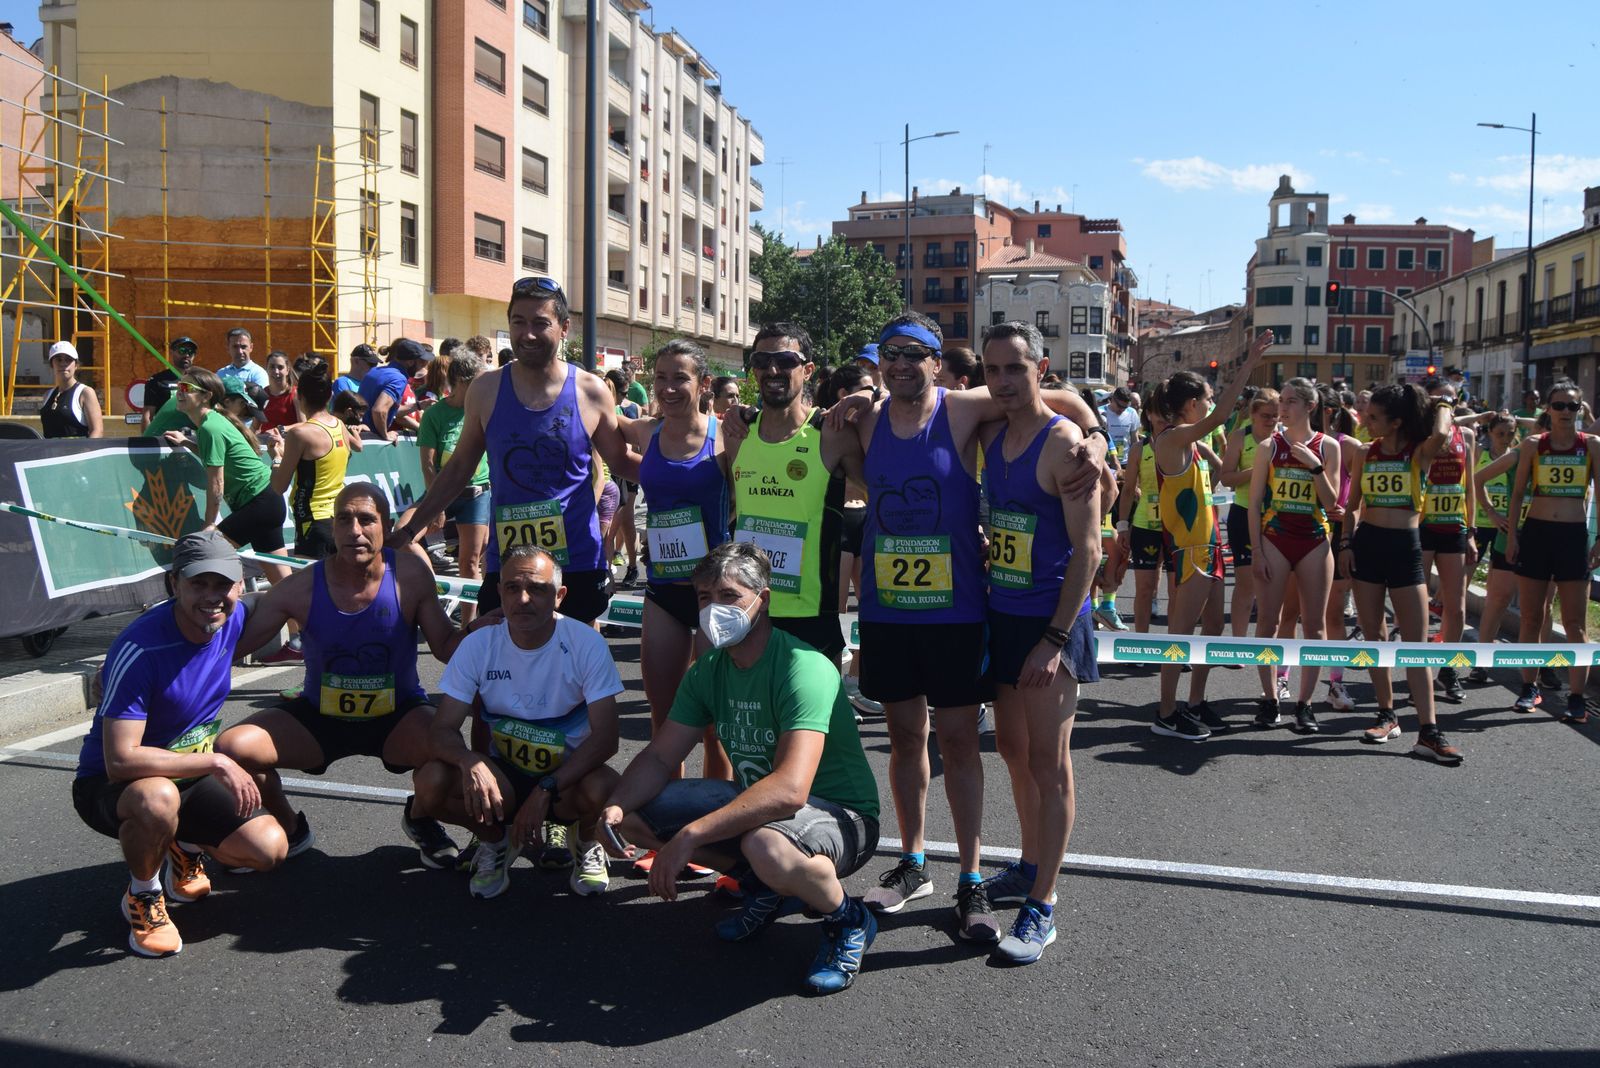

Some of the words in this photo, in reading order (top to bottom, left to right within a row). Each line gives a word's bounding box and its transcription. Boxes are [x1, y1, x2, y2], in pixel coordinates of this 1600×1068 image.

[762, 476, 778, 484] C.A.
[1550, 467, 1574, 484] 39
[1367, 474, 1402, 492] 136
[748, 486, 758, 496] LA
[760, 486, 794, 498] BAÑEZA
[1277, 481, 1312, 500] 404
[512, 504, 551, 514] FUNDACION
[1432, 496, 1460, 512] 107
[512, 511, 527, 520] CAJA
[530, 510, 552, 518] RURAL
[658, 510, 692, 520] FUNDACION
[996, 512, 1027, 524] FUNDACION
[670, 518, 692, 526] RURAL
[756, 520, 797, 530] FUNDACION
[1006, 522, 1026, 531] RURAL
[504, 521, 558, 548] 205
[772, 528, 796, 536] RURAL
[659, 538, 688, 558] MARÍA
[992, 532, 1016, 564] 55
[892, 558, 932, 586] 22
[770, 578, 797, 588] RURAL
[1004, 574, 1028, 584] RURAL
[897, 596, 917, 604] CAJA
[918, 595, 948, 603] RURAL
[486, 670, 512, 680] BBVA
[339, 692, 376, 714] 67
[512, 692, 548, 710] 224
[514, 723, 556, 739] FUNDACION
[514, 730, 530, 740] CAJA
[531, 735, 556, 744] RURAL
[502, 738, 552, 770] 149
